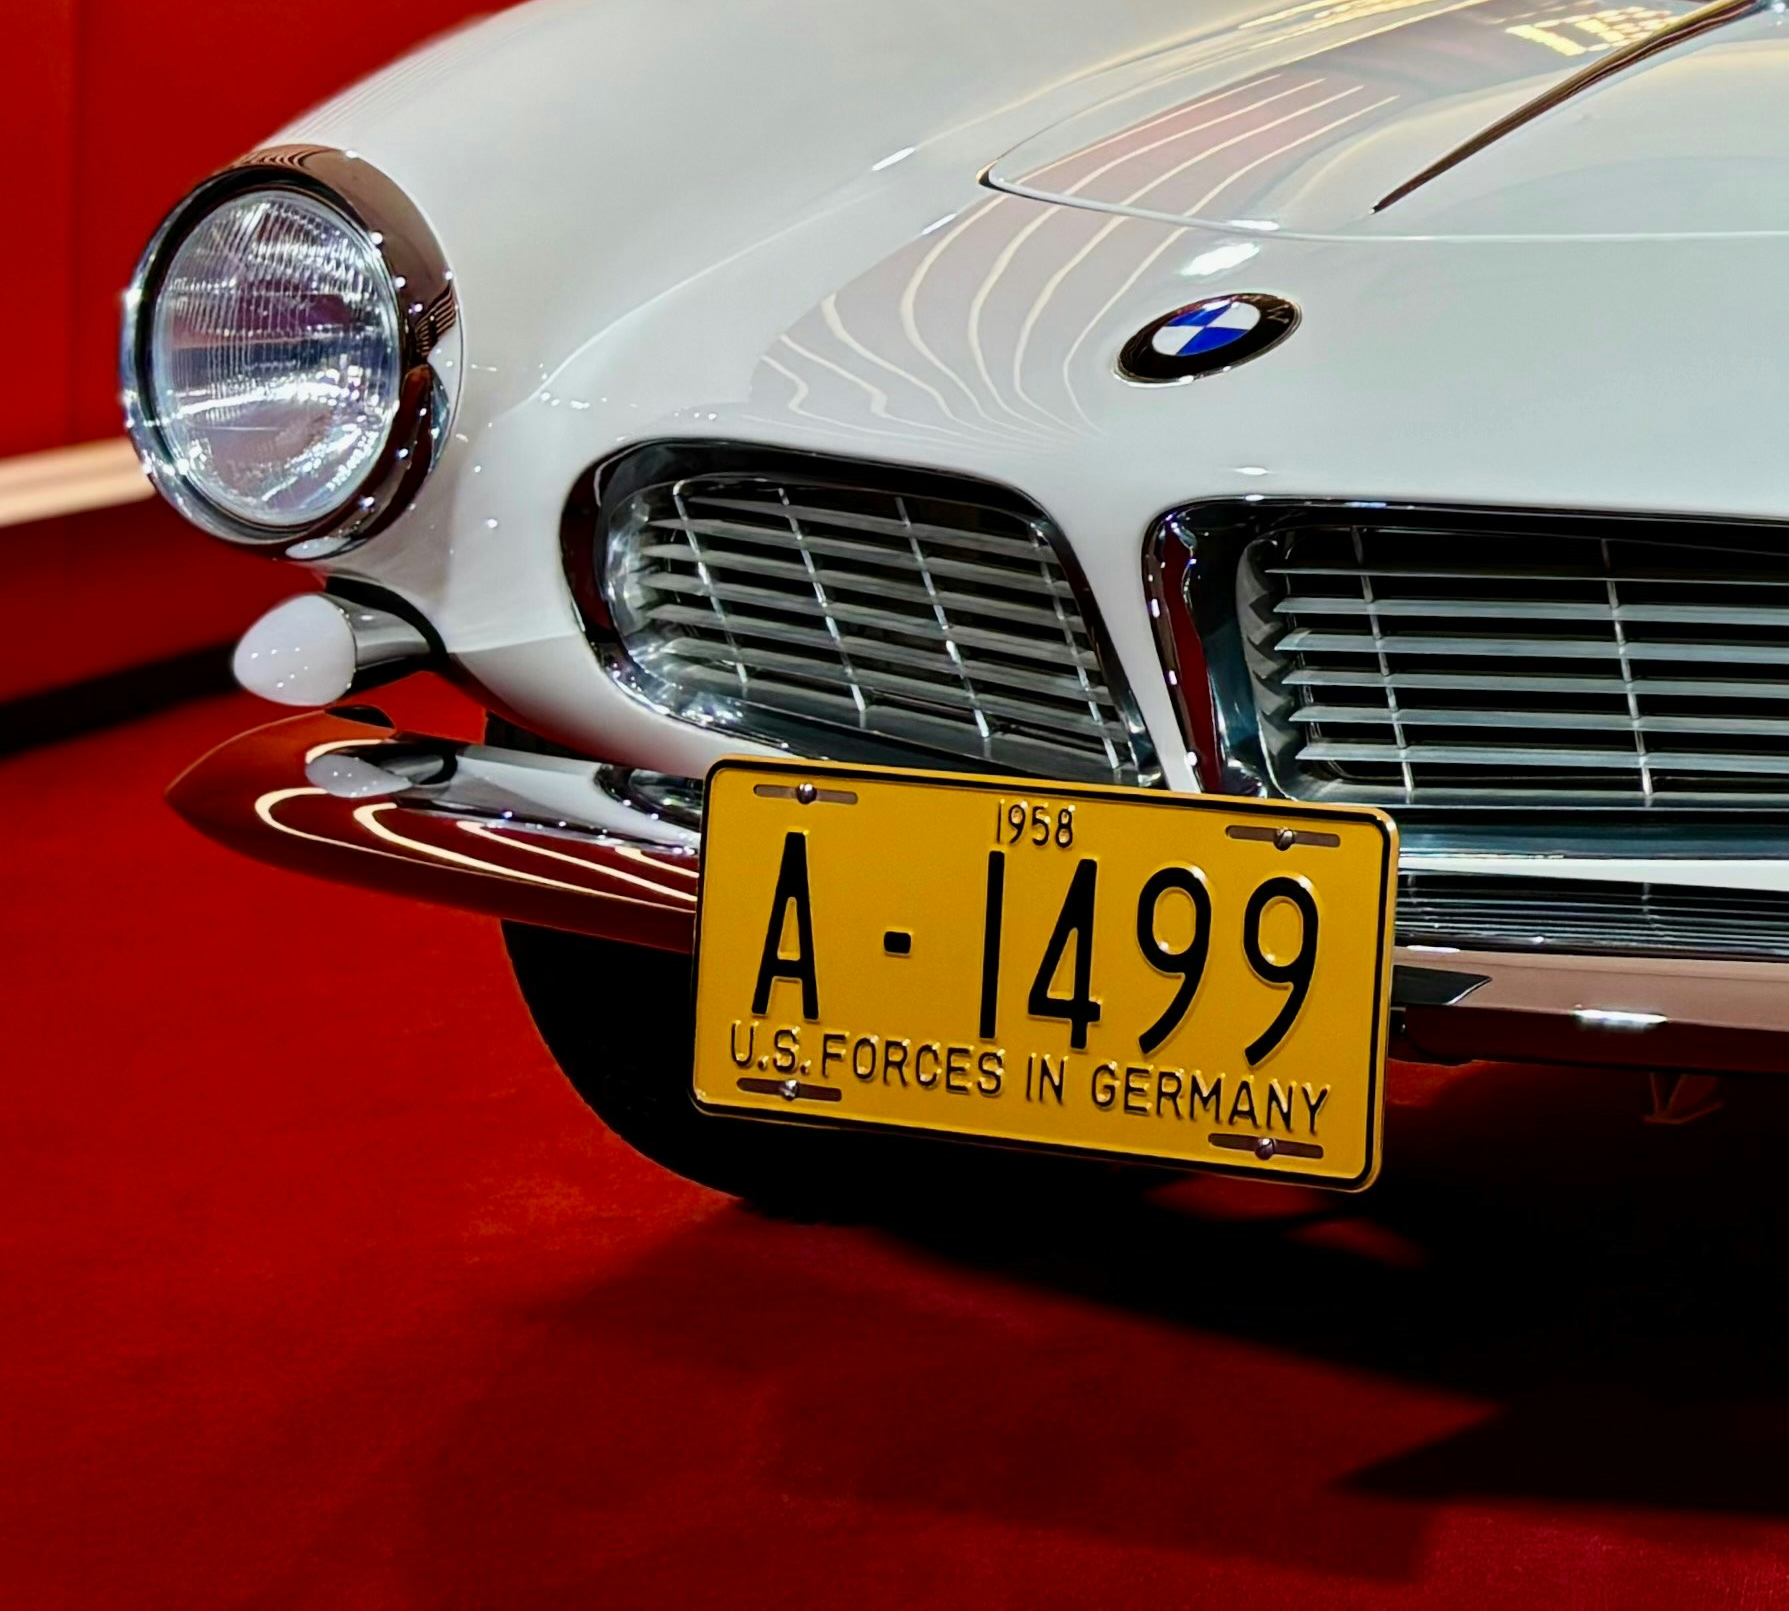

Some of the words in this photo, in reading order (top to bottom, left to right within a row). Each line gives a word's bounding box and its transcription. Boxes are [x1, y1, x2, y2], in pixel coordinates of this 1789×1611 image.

[995, 798, 1076, 849] 1958
[1025, 1052, 1070, 1105] IN
[1090, 1060, 1332, 1135] GERMANY
